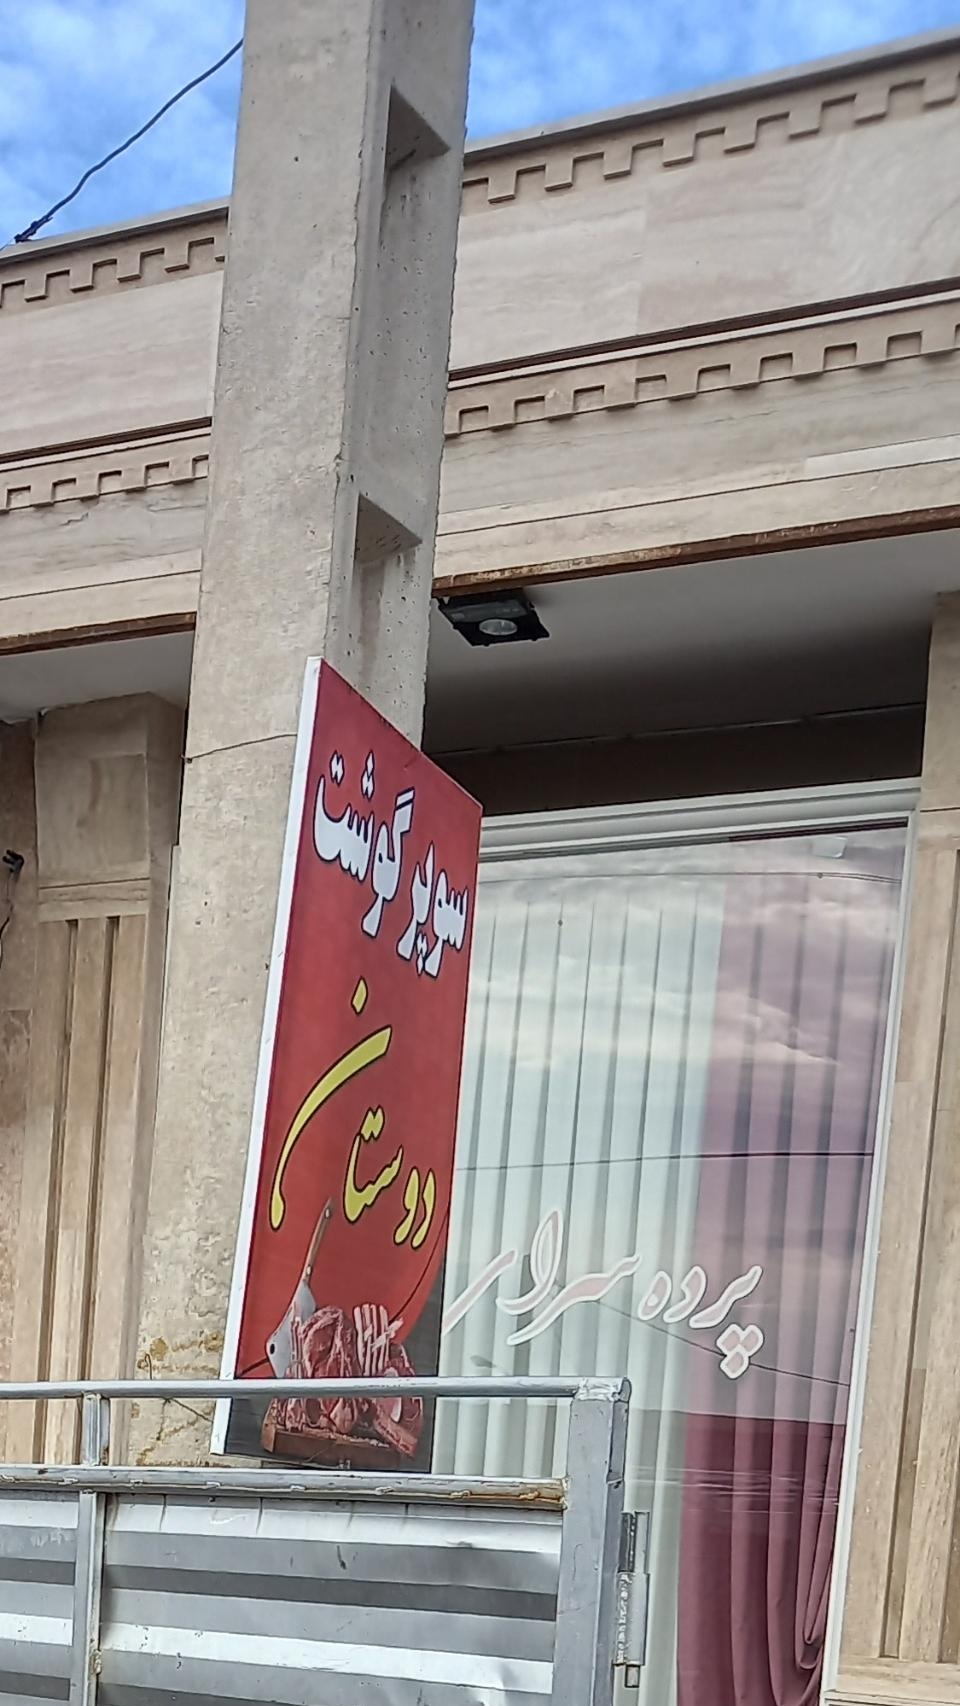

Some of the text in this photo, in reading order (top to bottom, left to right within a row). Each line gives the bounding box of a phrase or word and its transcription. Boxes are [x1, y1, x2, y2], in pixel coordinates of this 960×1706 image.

[312, 749, 469, 978] سوپر گوشت
[269, 976, 438, 1250] دوستان
[637, 1265, 765, 1380] پرده
